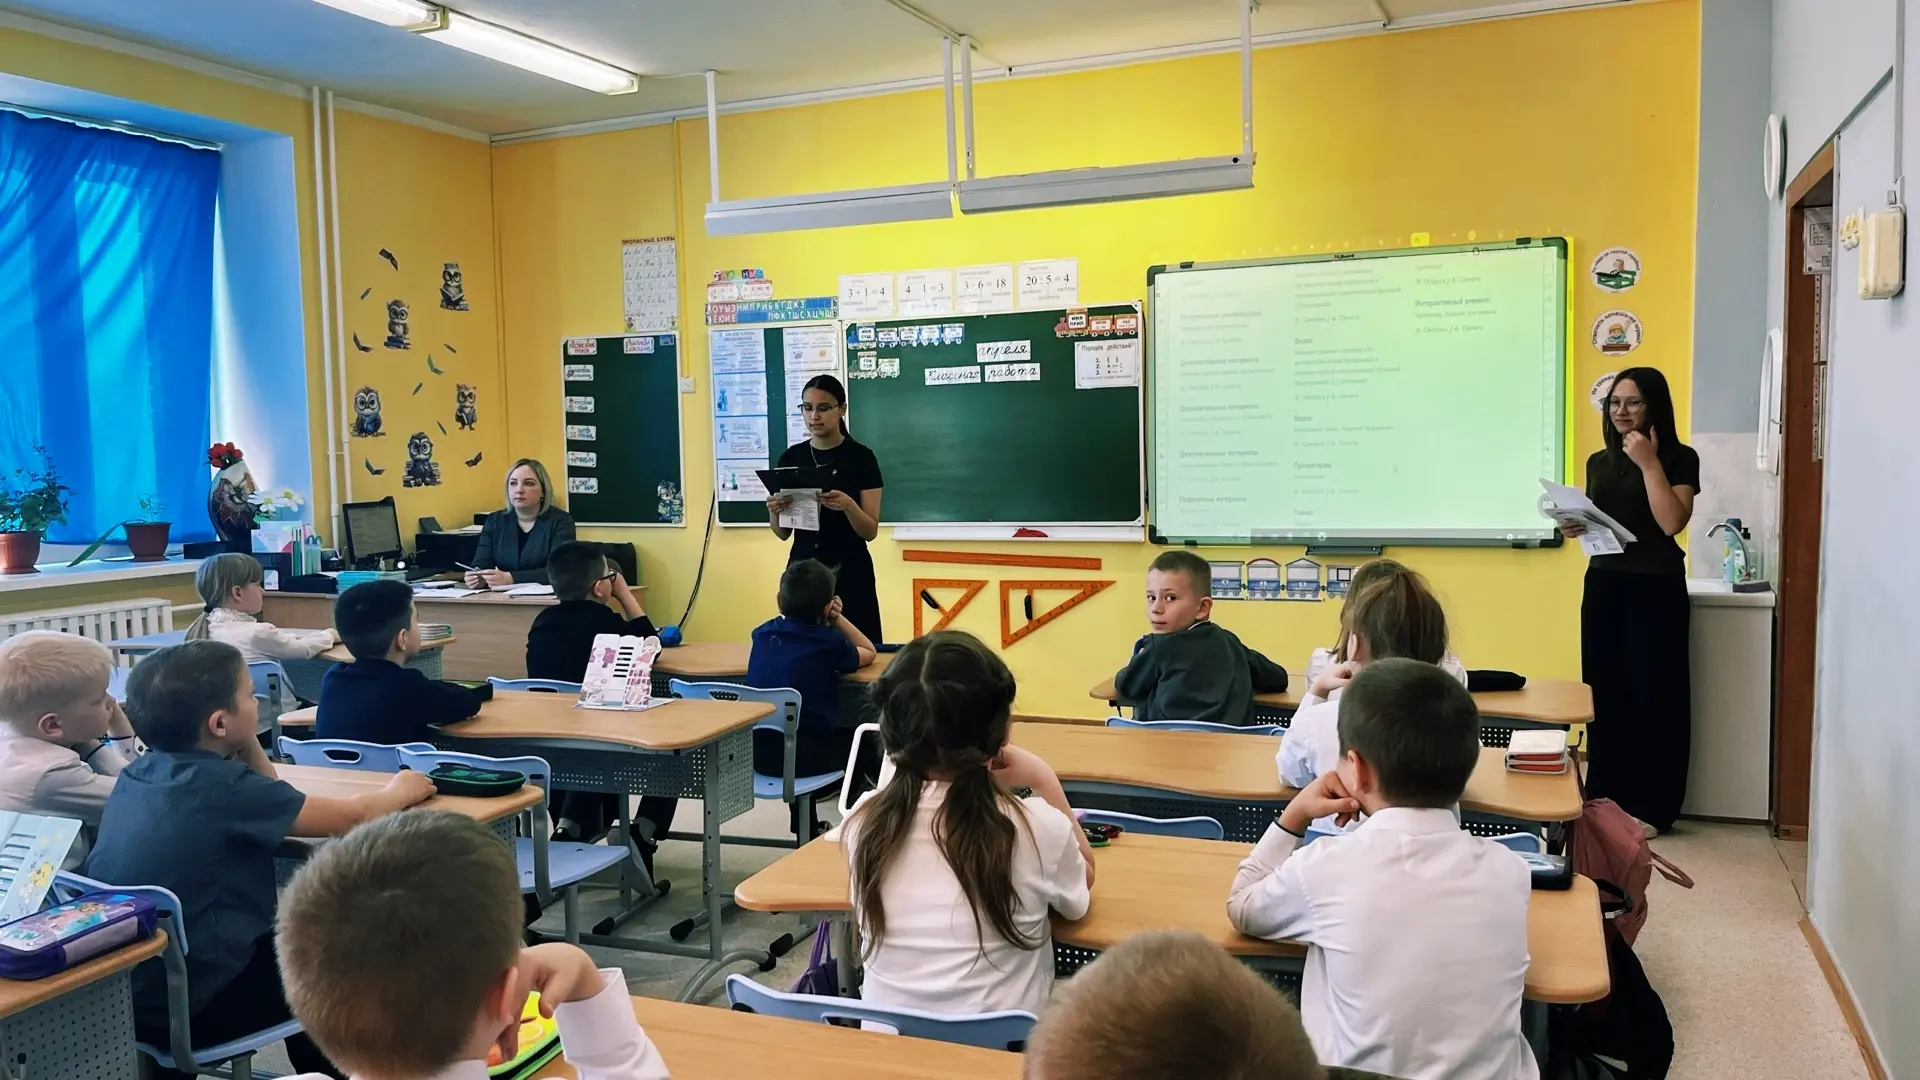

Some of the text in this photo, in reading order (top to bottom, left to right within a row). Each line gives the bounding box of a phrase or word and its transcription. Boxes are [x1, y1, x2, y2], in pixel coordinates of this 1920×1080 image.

[963, 280, 970, 290] 3
[977, 279, 984, 289] 6
[996, 278, 1006, 288] 18
[1026, 275, 1038, 286] 20
[1045, 274, 1052, 284] 5
[1063, 273, 1070, 283] 4
[848, 288, 854, 297] 3
[864, 287, 868, 297] 1
[879, 287, 885, 296] 4
[905, 284, 911, 294] 4
[922, 284, 927, 293] 1
[938, 282, 945, 292] 3
[1106, 343, 1132, 351] действий
[927, 369, 979, 381] Классная
